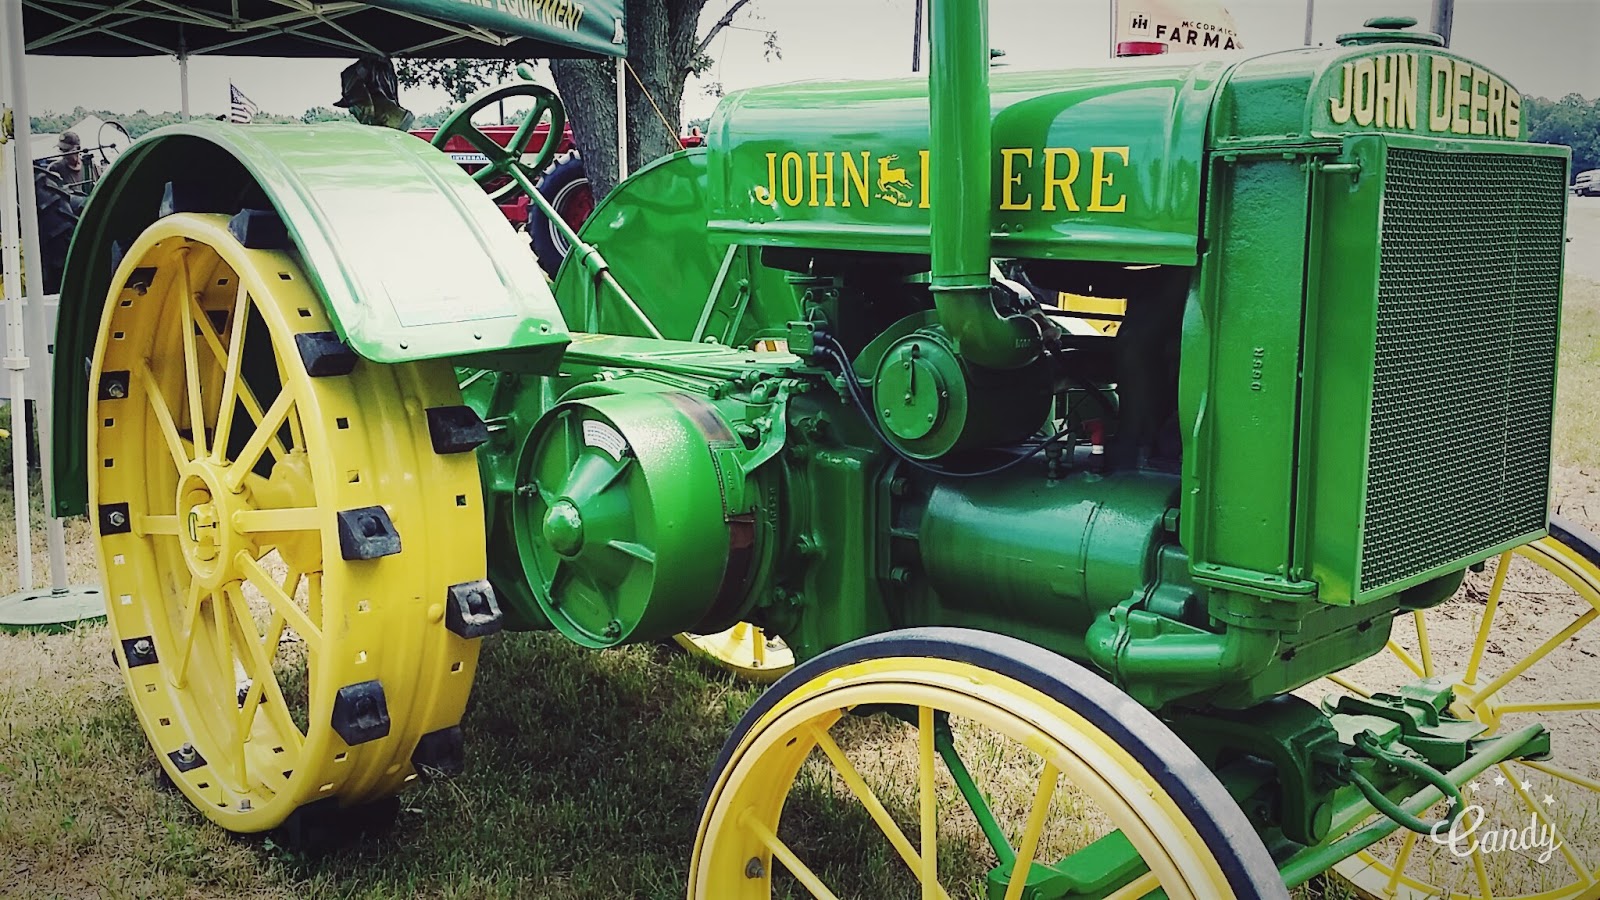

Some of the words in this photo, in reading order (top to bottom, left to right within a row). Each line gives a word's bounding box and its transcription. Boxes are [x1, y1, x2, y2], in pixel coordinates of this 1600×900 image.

[1156, 25, 1244, 50] FARMA
[1329, 54, 1419, 130] JOHN
[1429, 55, 1521, 138] DEERE
[754, 151, 871, 208] JOHN
[918, 147, 1130, 213] ERE
